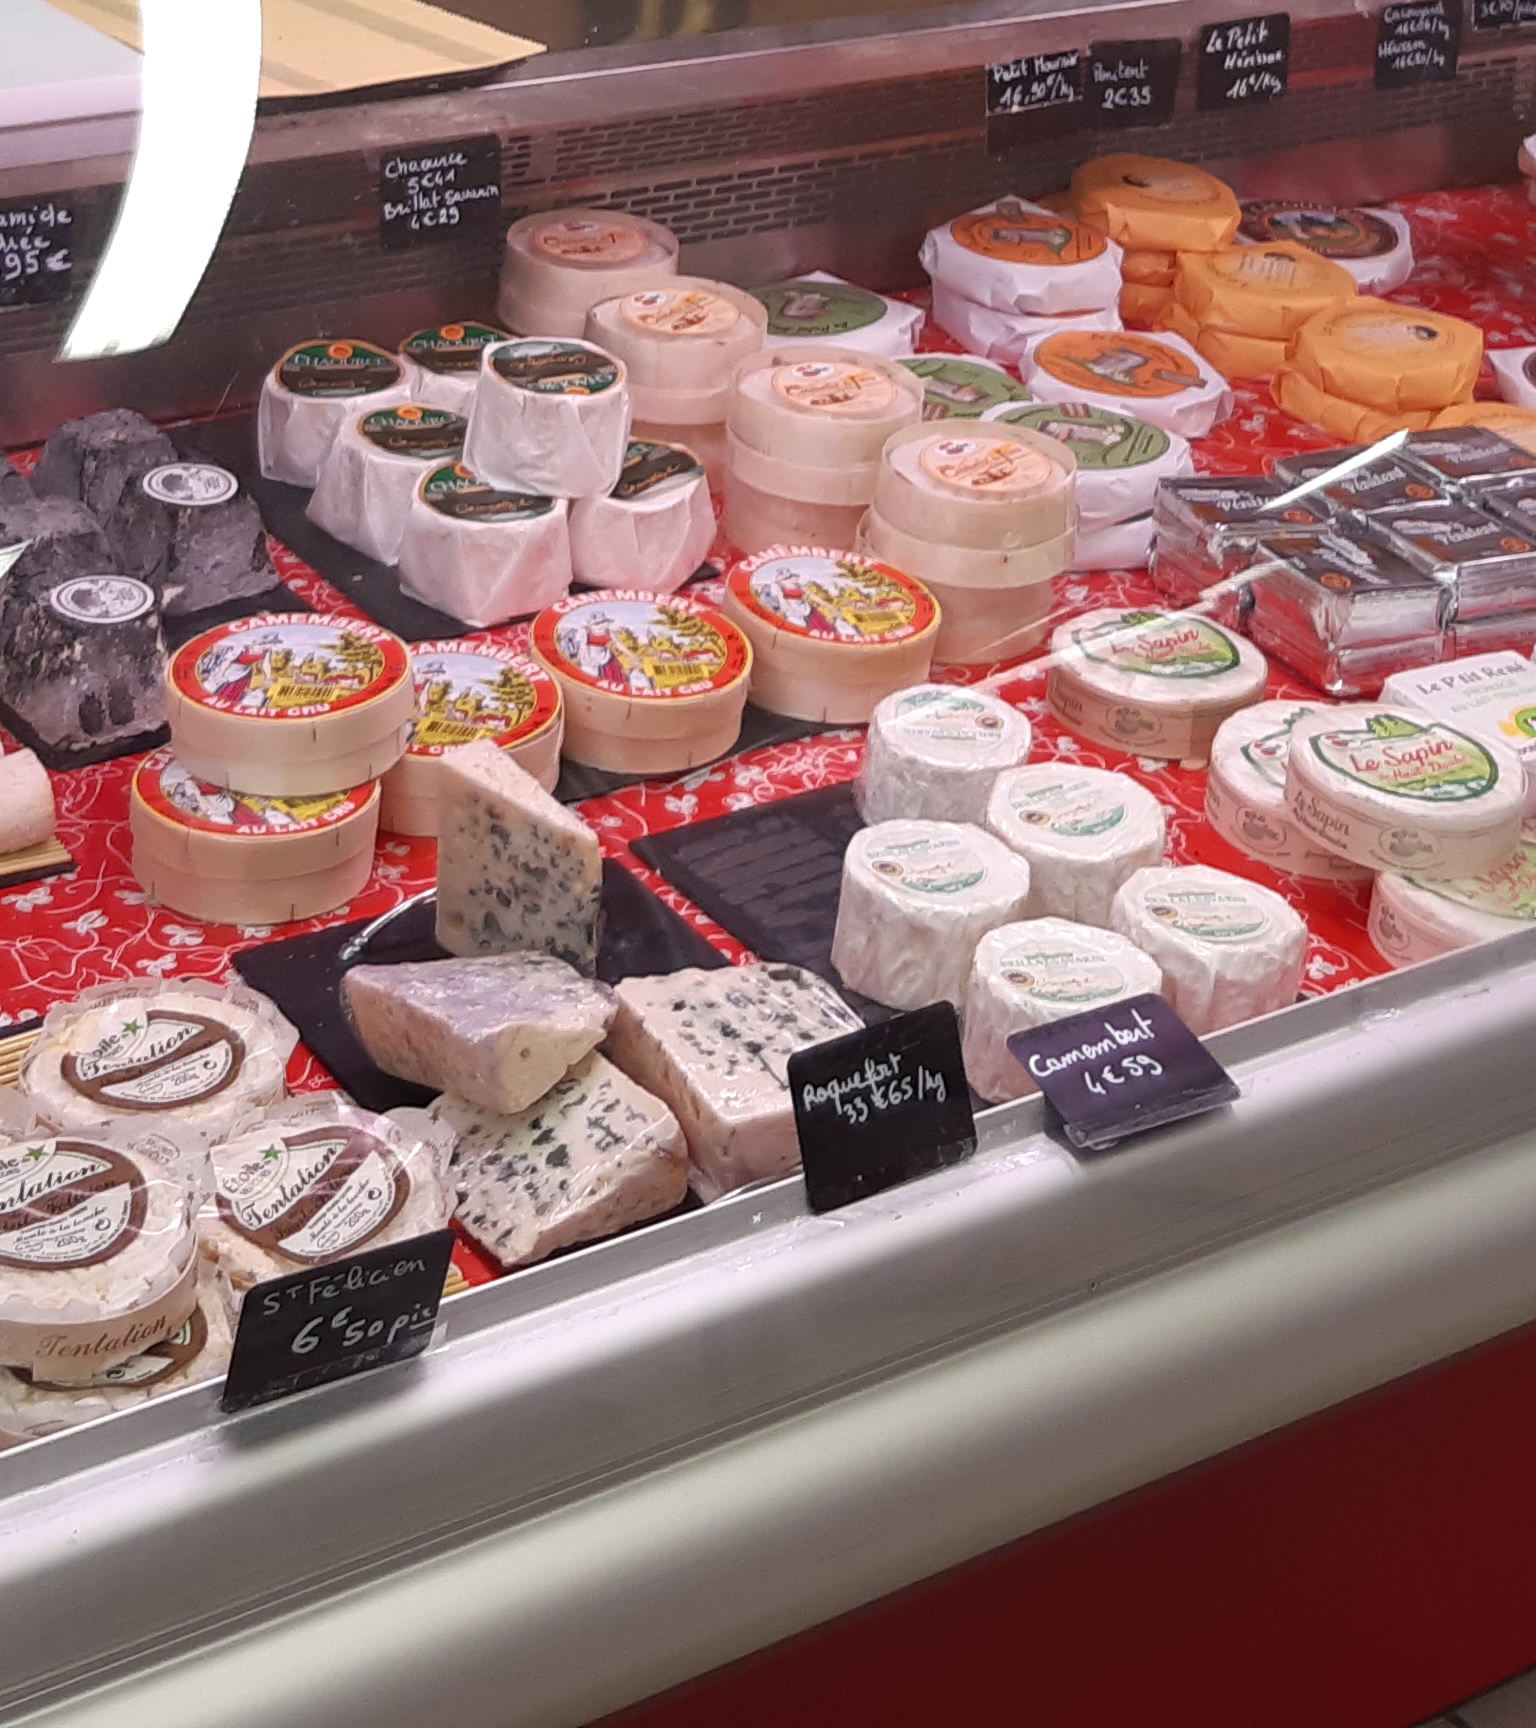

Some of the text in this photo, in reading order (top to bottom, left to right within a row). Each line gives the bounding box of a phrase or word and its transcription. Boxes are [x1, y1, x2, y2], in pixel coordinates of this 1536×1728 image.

[384, 190, 441, 221] Brillat
[738, 544, 879, 573] CAMEMBERT
[551, 589, 711, 616] CAMEMBERT
[227, 612, 394, 644] CAMEMBERT
[808, 628, 835, 641] AU
[840, 631, 882, 645] LAIT
[596, 678, 716, 699] AU LAIT CRU
[1416, 680, 1441, 696] Le
[202, 695, 333, 718] AU LAIT CRU
[1350, 738, 1456, 773] Le Sapin
[235, 800, 357, 836] AU LAIT CRU
[1026, 1009, 1156, 1077] Camembert
[802, 1052, 904, 1117] Roquefort
[240, 1144, 339, 1228] Tentation
[34, 1314, 170, 1360] Tentation
